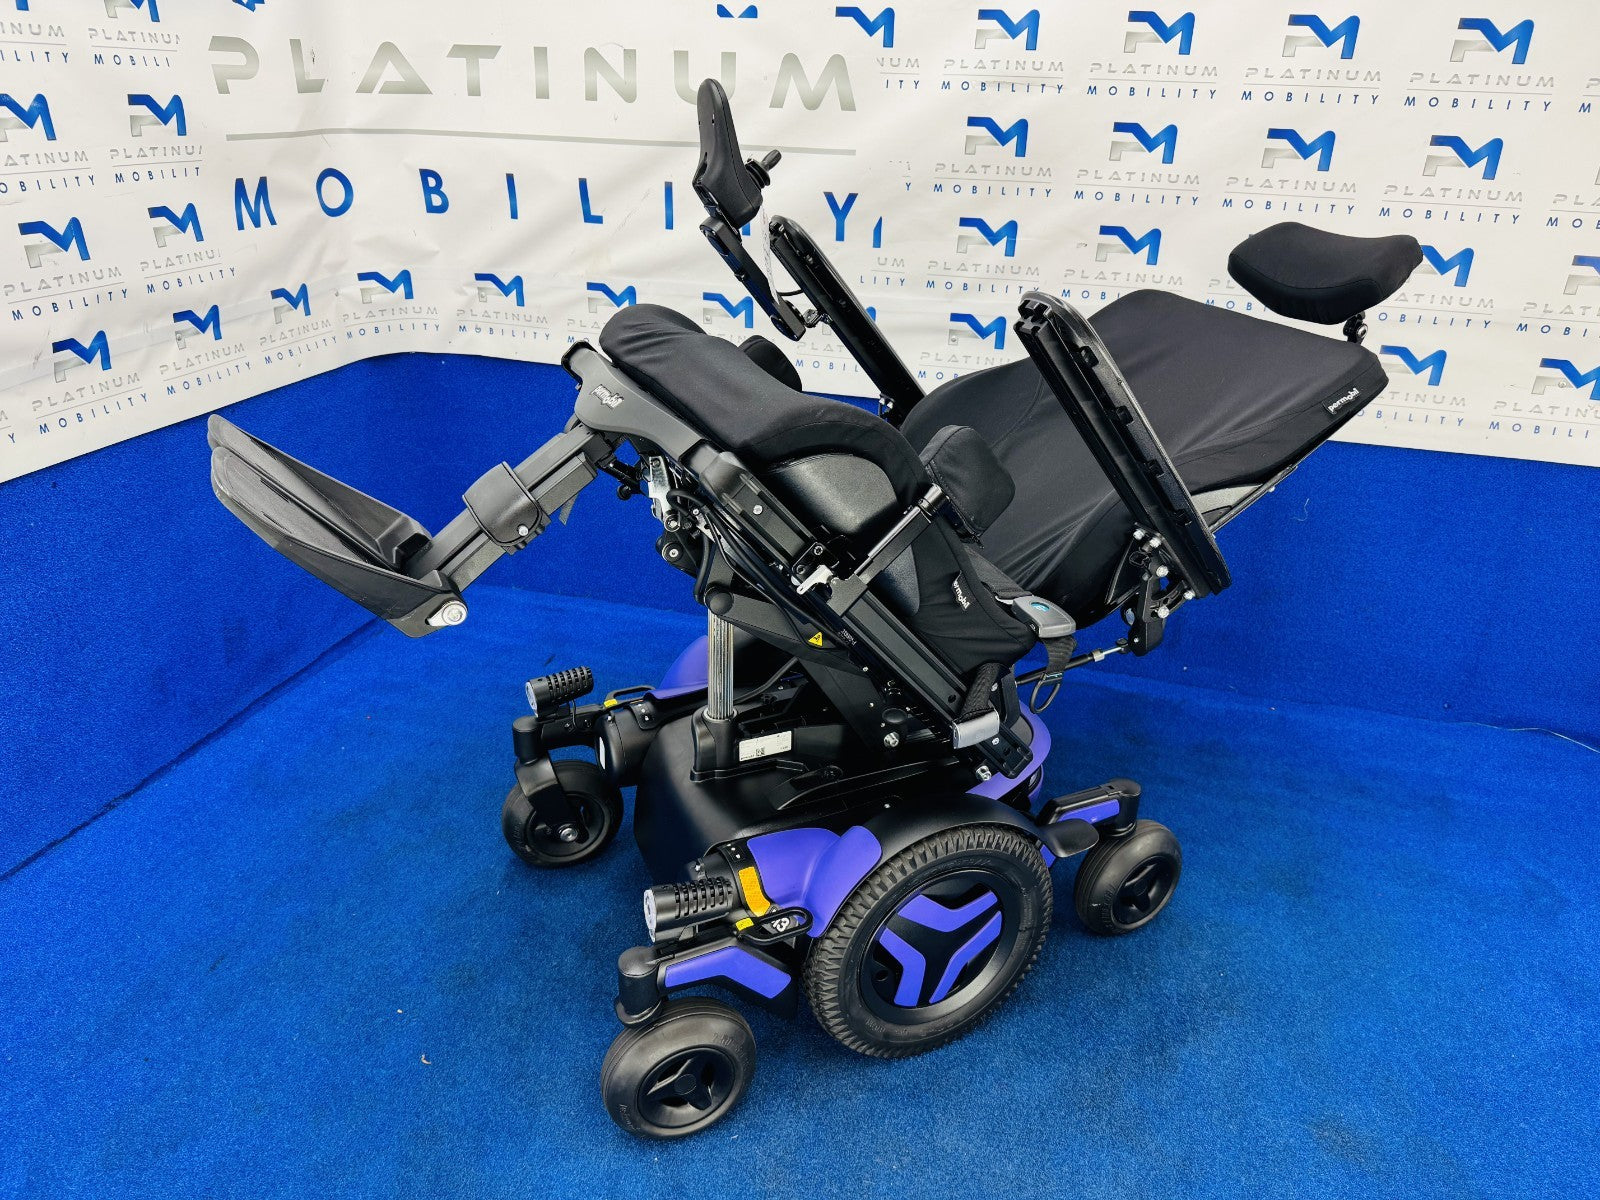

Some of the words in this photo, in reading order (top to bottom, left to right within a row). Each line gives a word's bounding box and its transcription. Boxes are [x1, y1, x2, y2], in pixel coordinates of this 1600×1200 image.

[93, 53, 170, 67] MOBILI
[943, 57, 1065, 73] PLATINUM
[207, 35, 857, 112] PLATINUM
[1089, 62, 1219, 78] PLATINUM
[1244, 66, 1383, 83] PLATINUM
[940, 80, 1064, 94] MOBILITY
[1408, 71, 1556, 89] PLATINUM
[1086, 85, 1217, 100] MOBILITY
[1240, 90, 1380, 105] MOBILITY
[1403, 96, 1553, 112] MOBILITY
[114, 166, 201, 184] MOBILIT
[934, 162, 1054, 178] PLATINUM
[1076, 169, 1201, 186] PLATINUM
[932, 183, 1053, 198] MOBILITY
[1225, 175, 1358, 195] PLATINUM
[1382, 184, 1524, 203] PLATINUM
[233, 166, 860, 243] MOBILIY
[1073, 190, 1200, 206] MOBILITY
[1221, 197, 1356, 216] MOBILITY
[1378, 206, 1521, 225] MOBILITY
[927, 260, 1040, 277] PLATINUM
[1062, 268, 1184, 286] PLATINUM
[3, 264, 123, 297] PLATINUM
[145, 266, 236, 295] MOBILITY
[11, 287, 129, 322] MOBILITY
[342, 305, 439, 323] PLATINUM
[456, 307, 549, 325] PLATINUM
[1378, 312, 1492, 330] OBILITY
[259, 317, 332, 347] PLATINUM
[346, 322, 441, 340] MOBILITY
[458, 324, 551, 341] MOBILITY
[1515, 321, 1600, 339] MOBI
[263, 334, 338, 365] MOBILITY
[159, 342, 246, 376] PLATINUM
[166, 360, 252, 396] MOBILITY
[31, 371, 142, 412] PLATINUM
[1327, 387, 1360, 413] permobil
[38, 391, 149, 436] MOBILITY
[953, 580, 971, 610] ermobil
